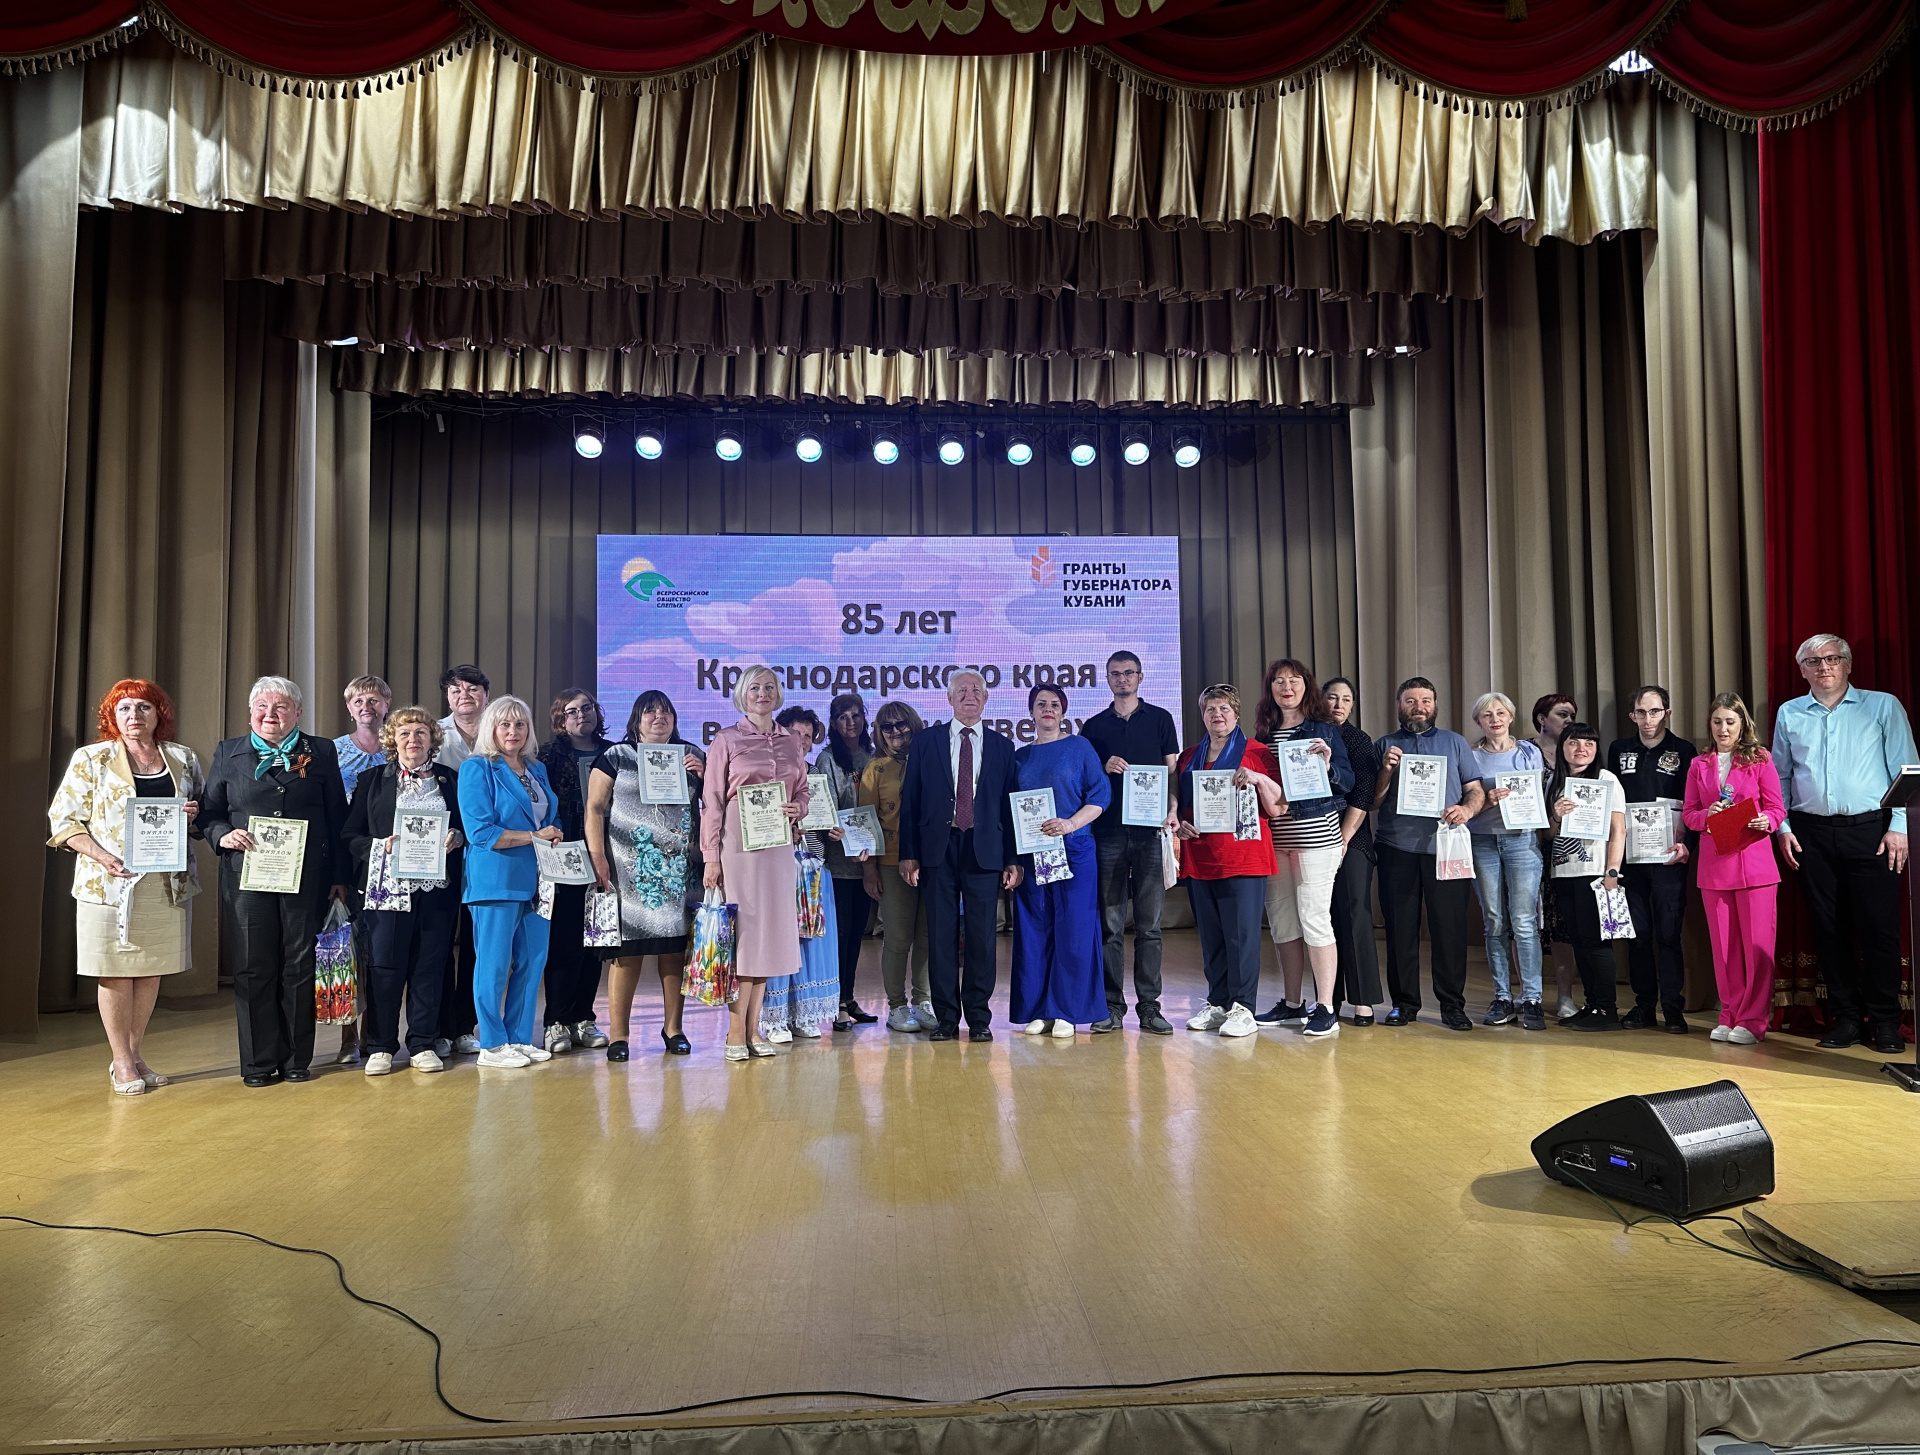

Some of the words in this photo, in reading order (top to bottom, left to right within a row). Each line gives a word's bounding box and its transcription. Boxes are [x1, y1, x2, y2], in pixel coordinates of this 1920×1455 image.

[1063, 563, 1126, 575] ГРАНТЫ
[1063, 579, 1172, 591] ГУБЕРНАТОРА
[1063, 595, 1126, 608] КУБАНИ
[841, 603, 884, 635] 85
[894, 610, 957, 634] лет
[697, 658, 1001, 697] Крнодарскоо
[1012, 664, 1096, 688] края
[1619, 756, 1637, 770] 56
